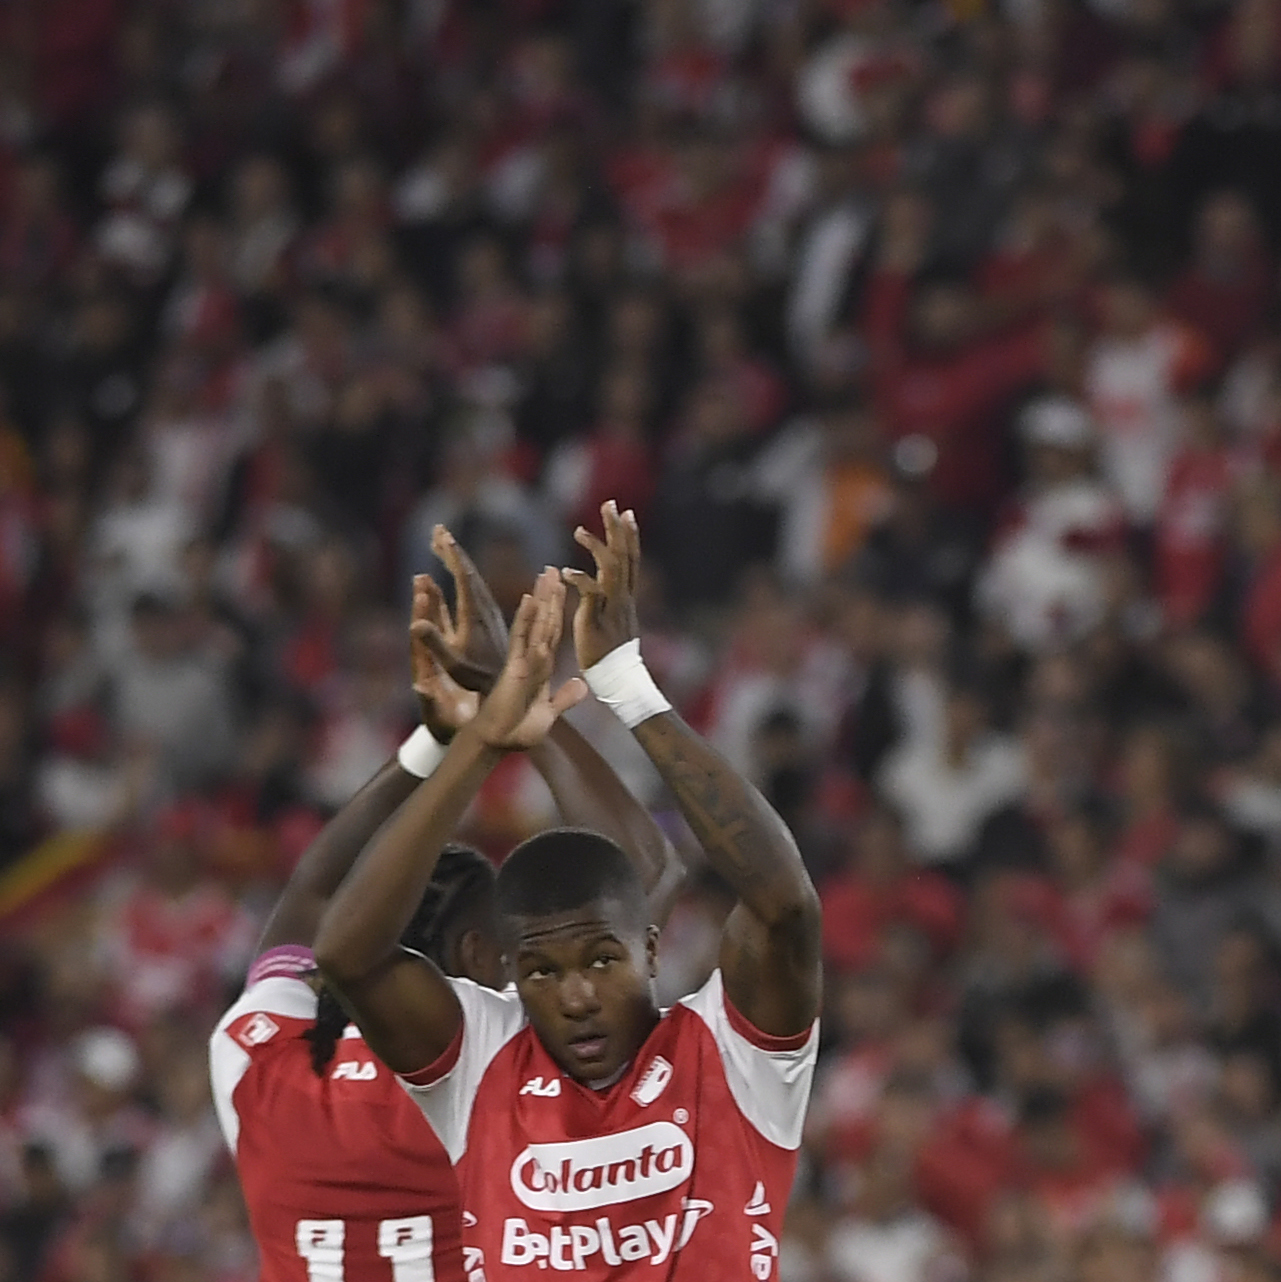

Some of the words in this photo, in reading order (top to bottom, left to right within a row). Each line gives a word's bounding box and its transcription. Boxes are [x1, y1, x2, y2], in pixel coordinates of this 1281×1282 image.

[519, 1077, 562, 1097] FILA
[520, 1142, 684, 1194] Colanta
[501, 1213, 679, 1271] BetPlay
